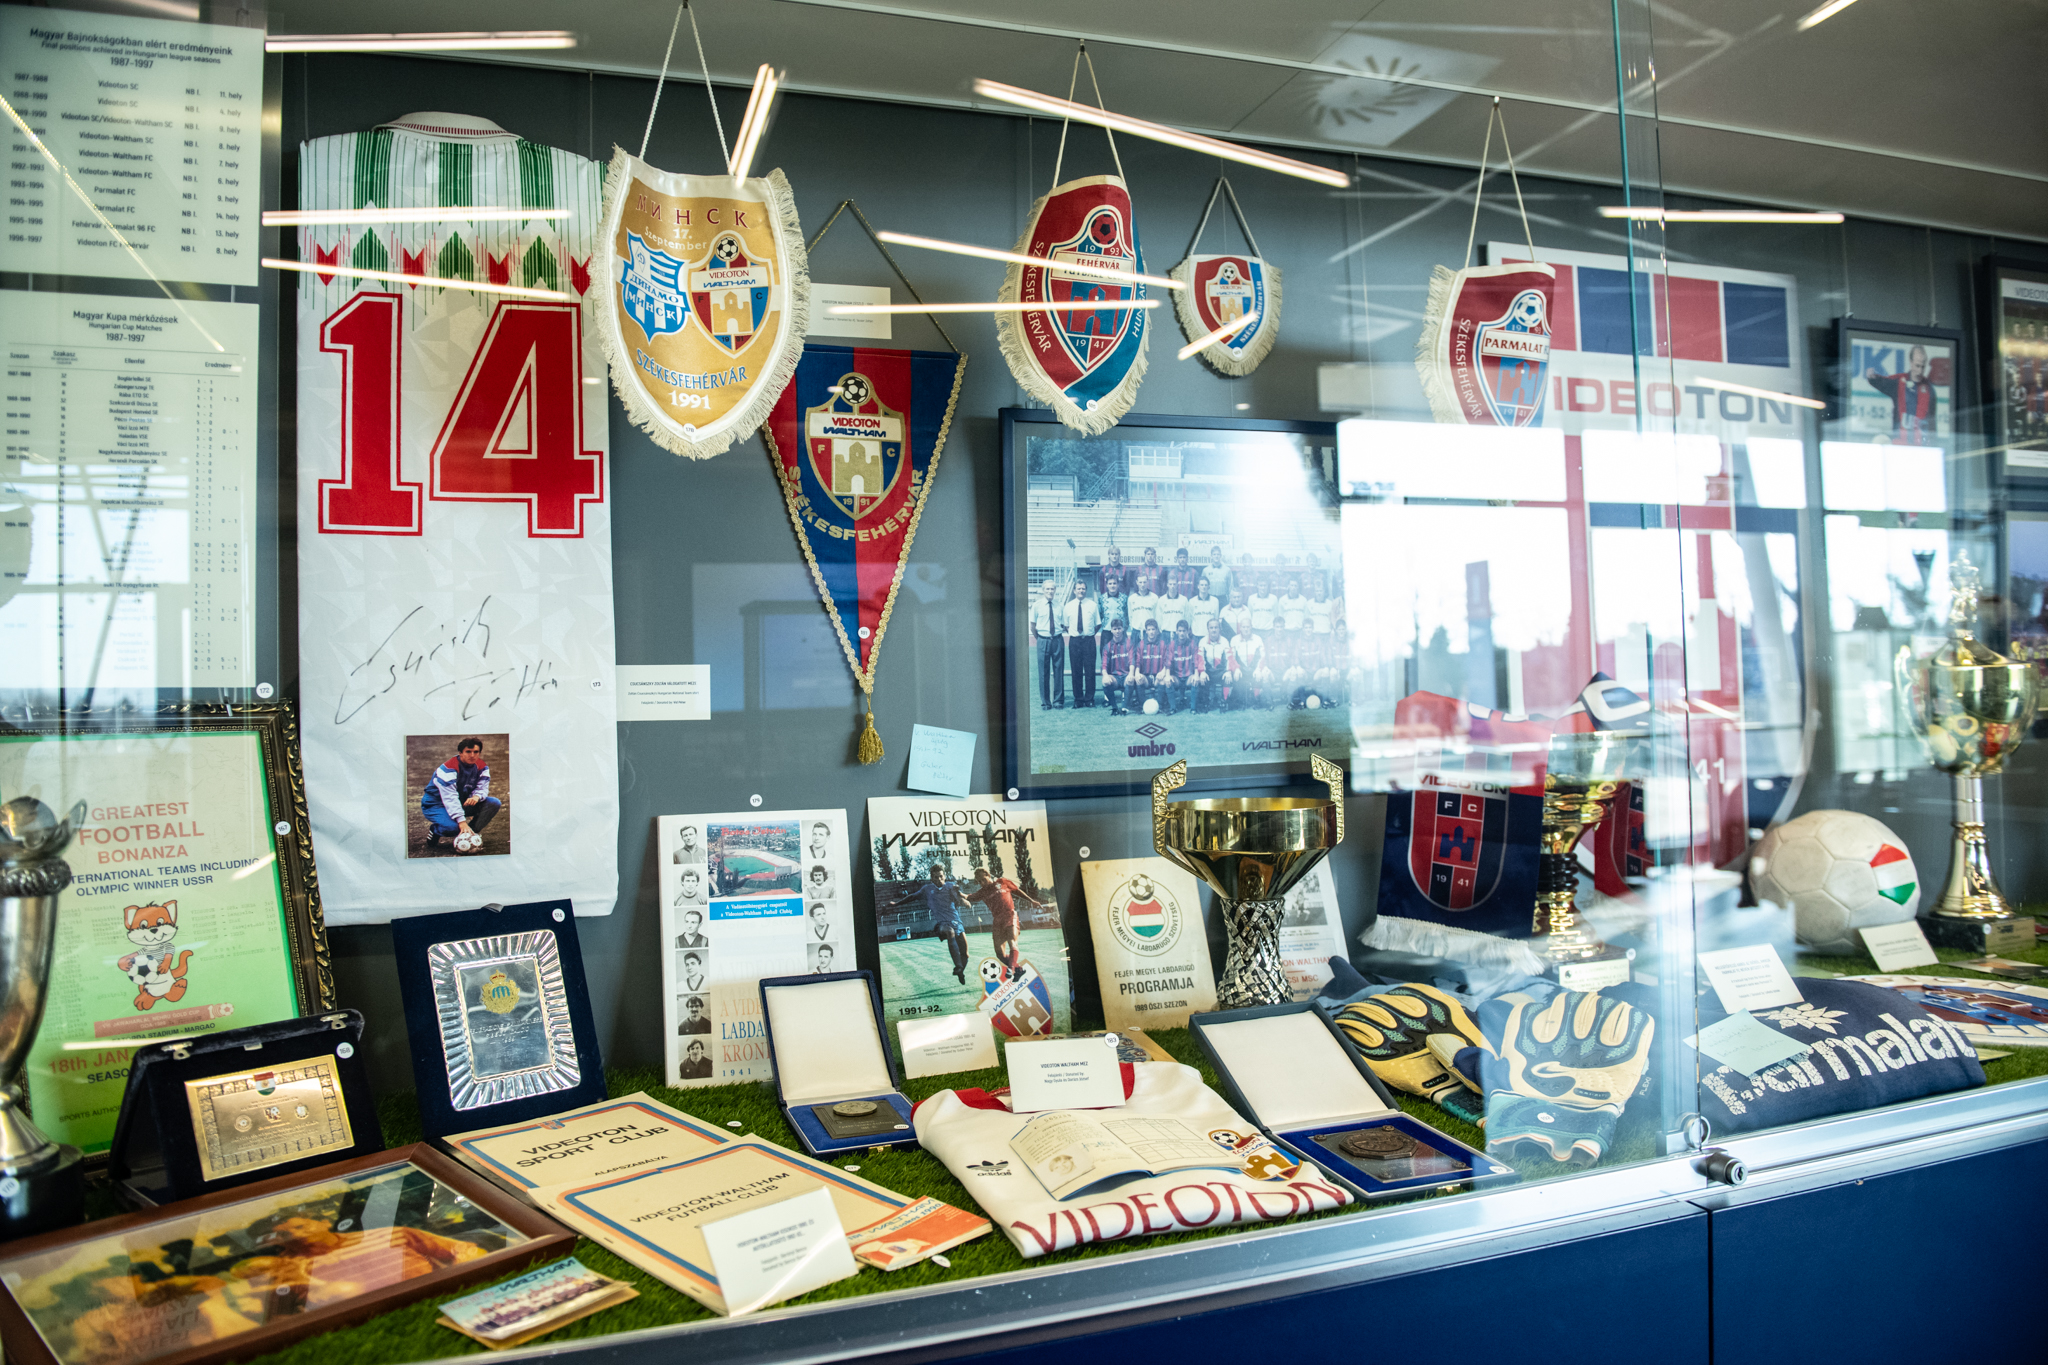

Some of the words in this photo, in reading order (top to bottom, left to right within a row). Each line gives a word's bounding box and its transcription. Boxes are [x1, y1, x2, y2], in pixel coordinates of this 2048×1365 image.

[30, 27, 64, 40] Magyar
[67, 31, 143, 48] Bajnokságokban
[146, 39, 167, 50] elért
[169, 42, 233, 56] eredményeink
[41, 41, 58, 50] Final
[60, 43, 91, 52] positions
[93, 45, 123, 54] achieved
[132, 50, 168, 60] Hungarian
[170, 52, 192, 62] league
[193, 55, 221, 64] seasons
[110, 57, 154, 68] 1987-1997
[98, 80, 128, 90] Videoton
[98, 98, 128, 107] Videoton
[61, 112, 90, 122] Videoton
[79, 131, 144, 144] Videoton-Waltham
[78, 149, 143, 161] Videoton-Waltham
[78, 167, 142, 179] Videoton-Waltham
[94, 186, 126, 196] Parmalat
[636, 194, 752, 230] МИНСК
[72, 220, 102, 230] Fehérvár
[644, 226, 708, 250] Szeptember
[673, 228, 692, 240] 17.
[77, 238, 108, 248] Videoton
[1085, 244, 1096, 252] 19
[1110, 247, 1120, 256] 93
[1076, 258, 1120, 270] FEHÉRVÁR
[709, 270, 750, 280] VIDEOTON
[630, 274, 679, 304] ДИНАМО
[703, 279, 756, 288] WALTHAM
[756, 292, 763, 300] C
[1024, 240, 1052, 352] SZKESFEÉRVÁR
[627, 291, 676, 320] МИНСК
[73, 310, 104, 322] Magyar
[106, 312, 127, 323] Kupa
[129, 312, 178, 324] mérkőzések
[88, 322, 121, 332] Hungarian
[122, 323, 134, 332] Cup
[136, 324, 162, 332] Matches
[106, 332, 145, 342] 1987-1997
[1094, 340, 1104, 348] 41
[1484, 337, 1543, 354] PARMALAT
[205, 362, 232, 370] Eredmény
[636, 348, 748, 390] SZÉKESFEHÉRVÁR
[1456, 318, 1482, 420] SZÉKESFEHÉRVÁR
[668, 390, 712, 410] 1991
[1553, 376, 1793, 426] IDEOTON
[318, 291, 604, 538] 14
[832, 416, 881, 429] VIDEOTON
[823, 426, 886, 438] WALTHAM
[817, 444, 826, 454] F
[886, 448, 896, 458] C
[788, 466, 924, 542] SZÉKESFEHÉRVÁR
[843, 498, 853, 506] 19
[860, 498, 870, 506] 91
[1128, 740, 1176, 758] umbro
[1242, 738, 1322, 751] WALTHAM
[1696, 758, 1726, 786] 41
[1418, 774, 1508, 795] VIDEOTON
[92, 802, 190, 822] GREATEST
[1467, 804, 1478, 812] C
[909, 810, 1006, 826] VIDEOTON
[79, 821, 205, 846] FOOTBALL
[721, 827, 750, 836] Botos
[753, 826, 787, 836] István
[882, 828, 1035, 848] WALTHAM
[98, 844, 188, 864] BONANZA
[927, 850, 969, 858] FUTBALL
[971, 849, 996, 857] CLUB
[71, 868, 154, 884] TERNATIONAL
[158, 864, 197, 876] TEAMS
[1436, 874, 1446, 882] 19
[1458, 878, 1470, 887] 41
[76, 882, 130, 897] OLYMPIC
[134, 878, 179, 891] WINNER
[183, 875, 214, 886] USSR
[1112, 906, 1120, 926] FEJÉR
[1116, 926, 1136, 948] MEGYEI
[1137, 938, 1171, 952] LABDARÚGÓ
[1114, 968, 1134, 978] FEJÉR
[1136, 967, 1156, 976] MEGYE
[1158, 962, 1196, 974] LABDARÚGÓ
[1301, 974, 1319, 982] MSC
[1119, 976, 1194, 996] PROGRAMJA
[720, 1000, 729, 1016] A
[898, 1004, 942, 1016] 1991-92.
[1134, 1004, 1148, 1012] 1989
[1149, 1001, 1163, 1010] ŐSZI
[1164, 1000, 1188, 1009] SZEZON
[148, 1028, 180, 1038] STADIUM
[184, 1022, 216, 1034] MARGAO
[722, 1020, 766, 1040] LABDA
[48, 1057, 87, 1074] 18th
[93, 1048, 134, 1068] JAN.
[87, 1068, 130, 1084] SEASO
[59, 1110, 90, 1122] SPORTS
[516, 1143, 595, 1168] SPORT
[608, 1126, 670, 1144] CLUB
[521, 1124, 638, 1155] VIDEOTON
[594, 1154, 668, 1176] ALAPSZABÁLYA
[629, 1172, 791, 1223] VIDEOTON-WALTHAM
[666, 1196, 734, 1222] FUTBALL
[737, 1184, 779, 1200] CLUB
[1011, 1178, 1347, 1254] VIDEOTON
